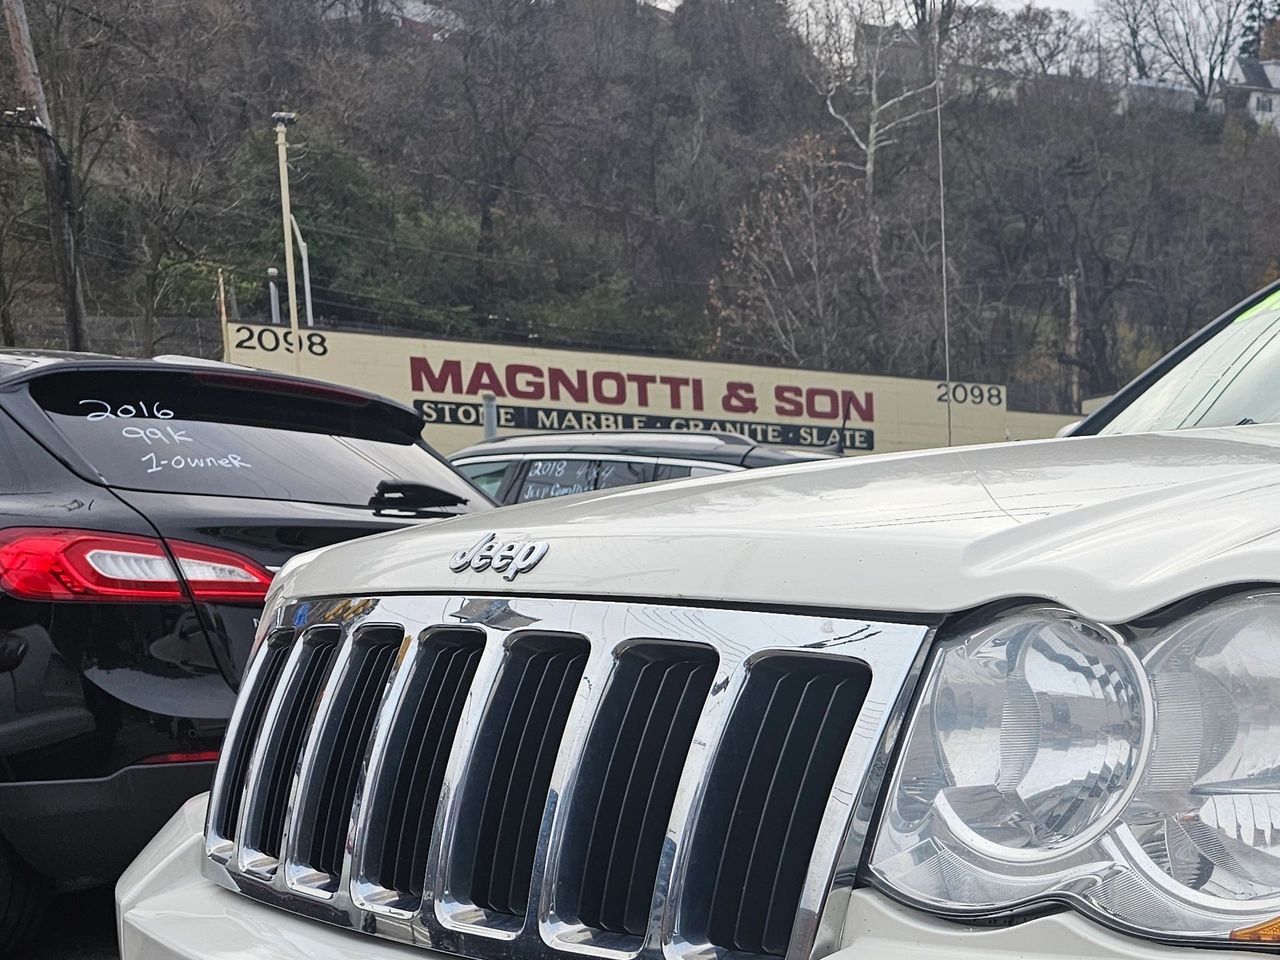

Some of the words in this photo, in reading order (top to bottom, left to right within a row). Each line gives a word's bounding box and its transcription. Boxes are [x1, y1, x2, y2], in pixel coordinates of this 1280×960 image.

[235, 326, 328, 356] 2098
[410, 356, 704, 411] MAGNOTTI
[722, 381, 759, 415] &
[774, 385, 875, 423] SON
[937, 383, 1002, 406] 2098
[79, 399, 175, 421] 2016
[528, 461, 568, 477] 2018
[449, 531, 550, 582] Jeep
